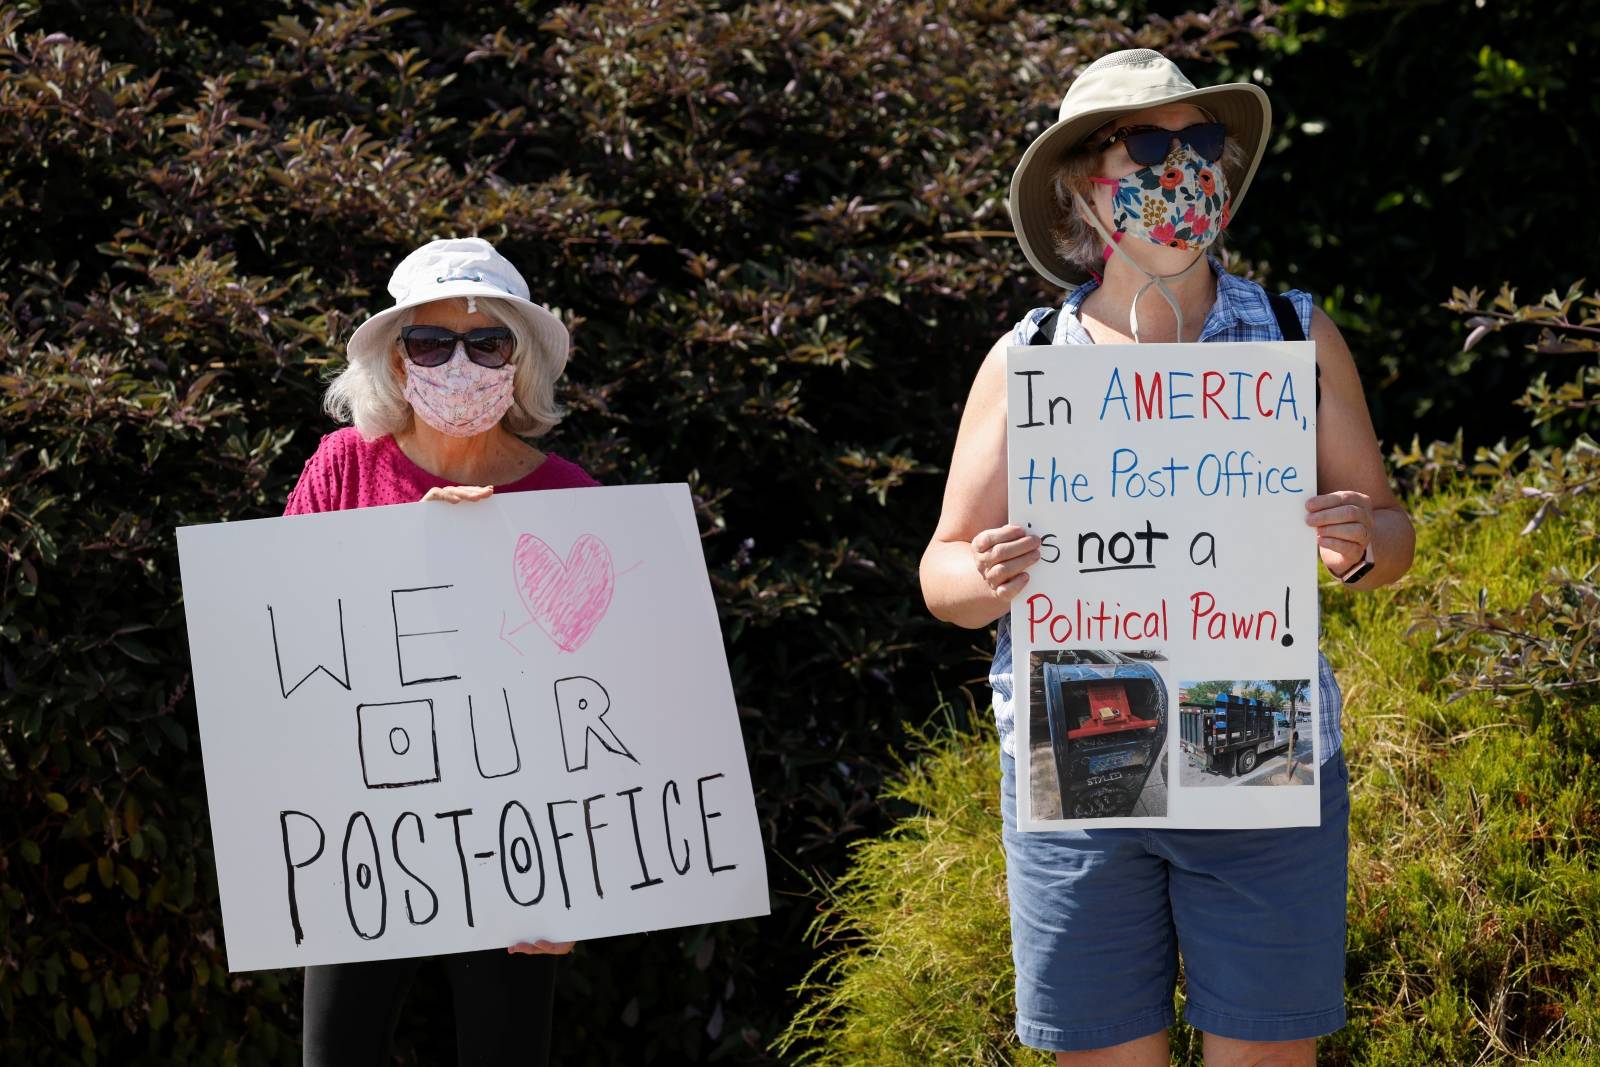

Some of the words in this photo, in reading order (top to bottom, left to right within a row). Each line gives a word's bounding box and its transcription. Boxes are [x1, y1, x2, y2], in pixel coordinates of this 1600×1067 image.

[1014, 370, 1072, 428] In
[1099, 366, 1308, 431] AMERICA,
[1018, 456, 1094, 505] the
[1111, 448, 1189, 499] Post
[1196, 450, 1304, 499] Office
[1027, 522, 1061, 564] s
[1077, 519, 1169, 566] not
[1189, 531, 1217, 569] a
[266, 584, 462, 700] WE
[1026, 592, 1168, 644] Political
[1189, 586, 1295, 648] Pawn!
[356, 675, 641, 790] OUR
[278, 772, 738, 948] POST-OFFICE
